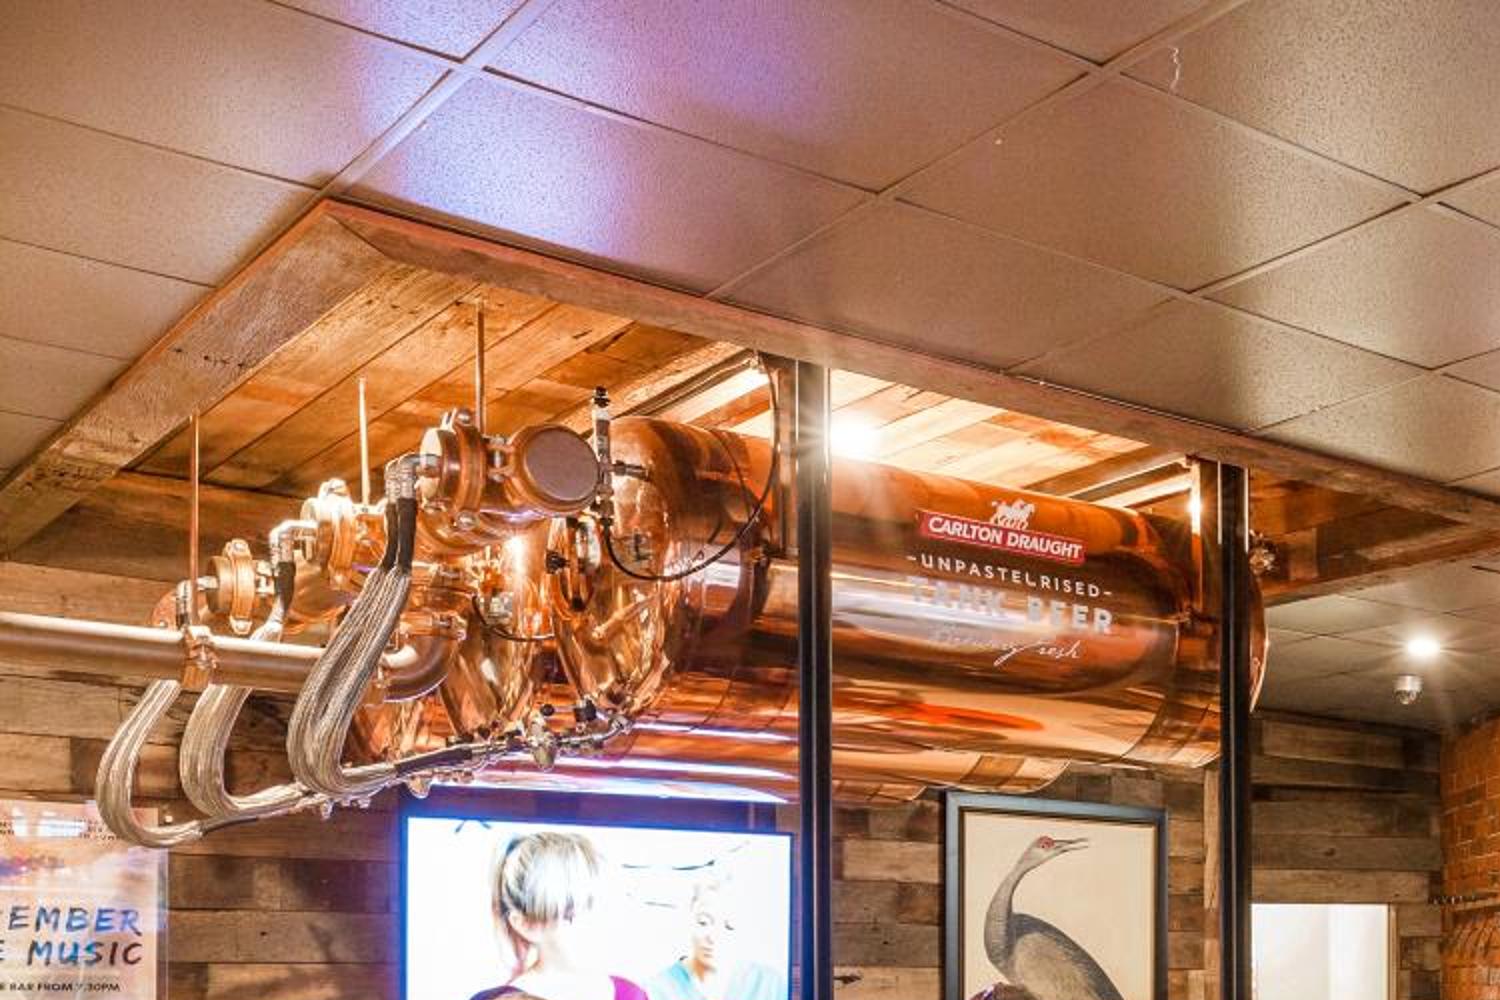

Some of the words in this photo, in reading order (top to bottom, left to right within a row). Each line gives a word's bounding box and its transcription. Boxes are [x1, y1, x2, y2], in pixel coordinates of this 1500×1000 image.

[929, 517, 1003, 545] CARLTON
[1006, 532, 1083, 559] DRAUGHT
[27, 939, 143, 966] MUSIC
[37, 982, 73, 992] FROM
